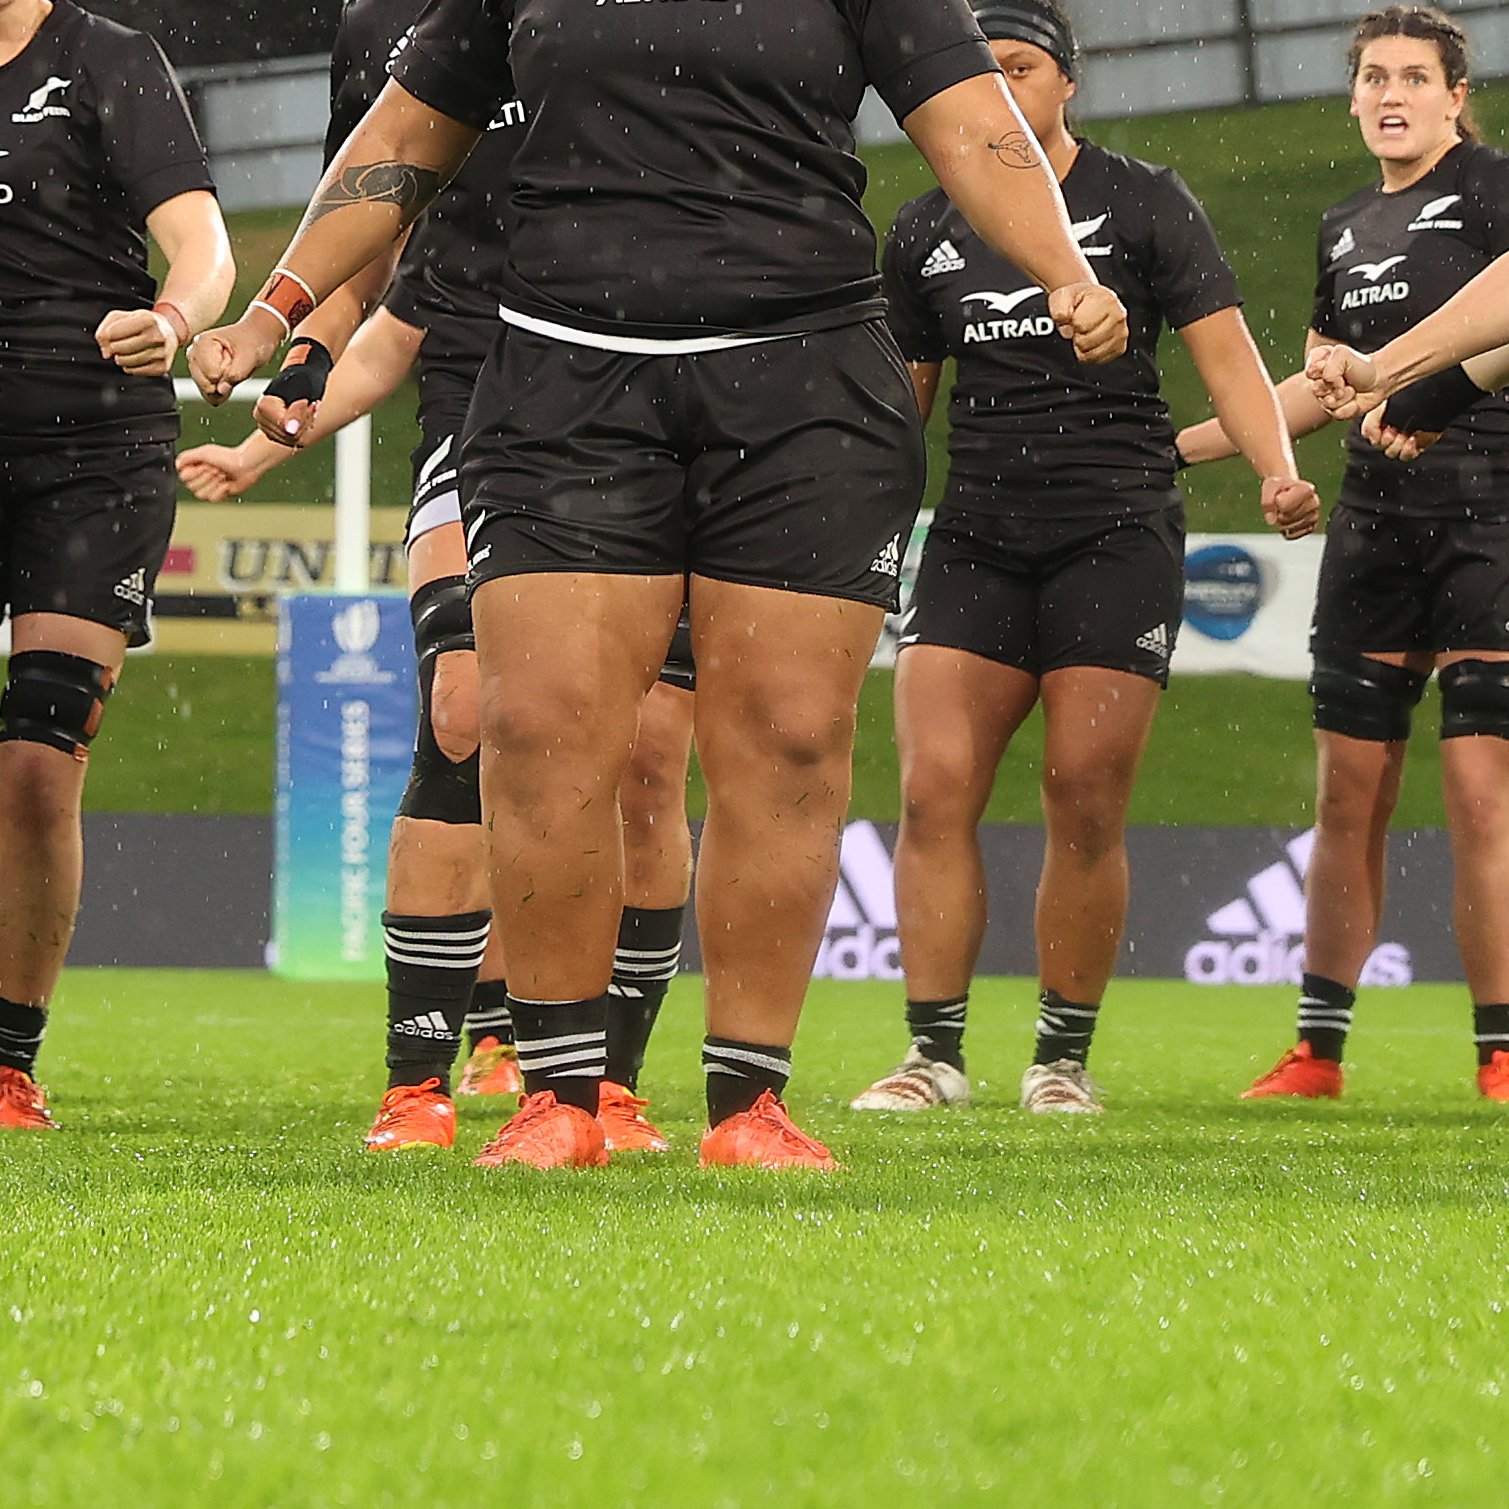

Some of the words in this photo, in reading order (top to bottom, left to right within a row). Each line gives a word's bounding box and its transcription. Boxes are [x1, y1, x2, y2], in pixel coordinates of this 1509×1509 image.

[1341, 281, 1409, 310] ALTRAD
[963, 315, 1055, 343] ALTRAD
[340, 791, 371, 865] FOUR
[393, 1022, 455, 1041] adidas
